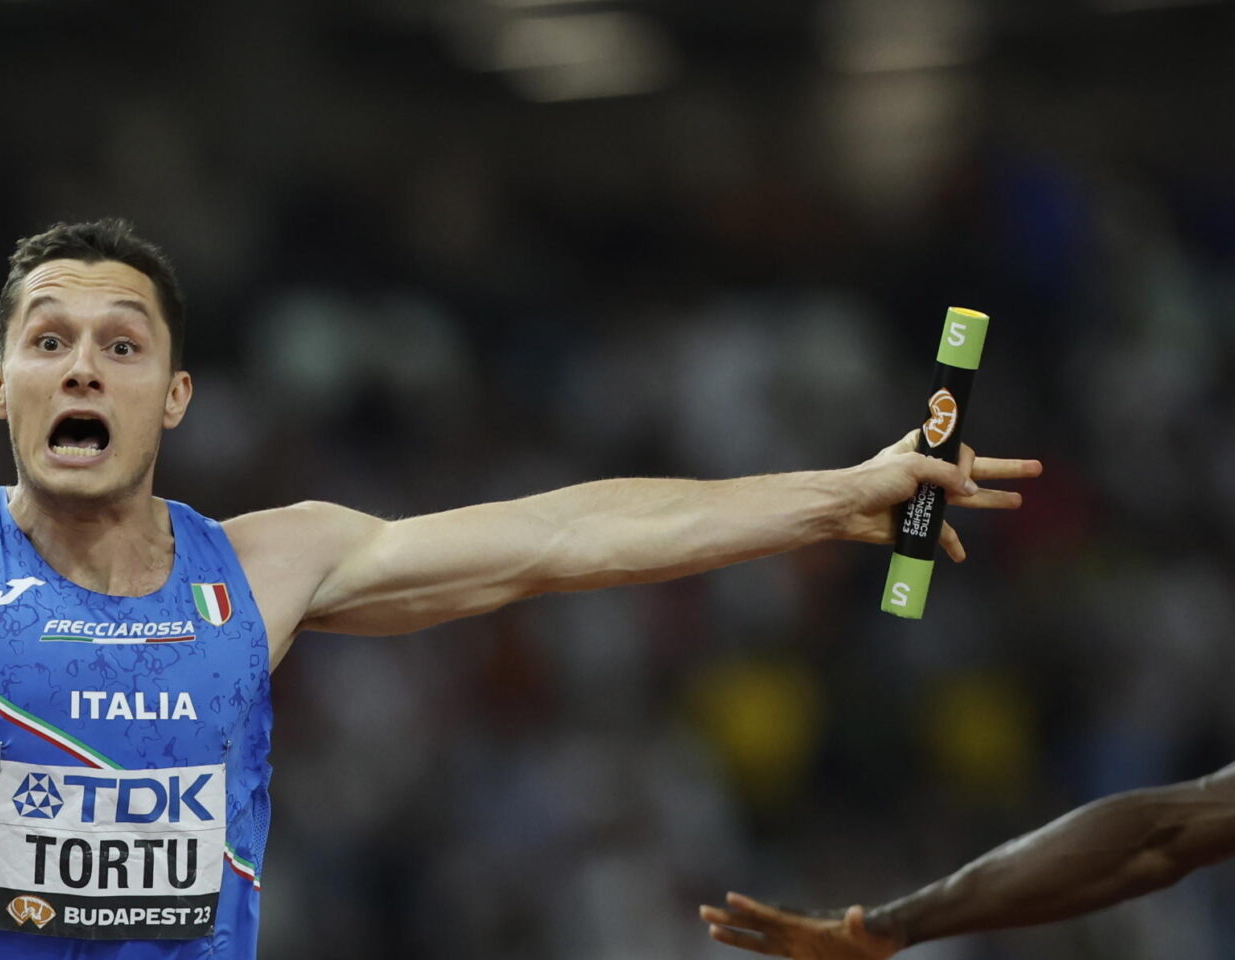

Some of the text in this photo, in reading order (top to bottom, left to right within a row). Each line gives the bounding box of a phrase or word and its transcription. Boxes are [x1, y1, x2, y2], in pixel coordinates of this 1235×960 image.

[947, 321, 967, 347] 5
[902, 518, 912, 534] 23
[919, 490, 936, 538] ATHLETICS
[890, 582, 911, 607] 5
[43, 619, 195, 636] FRECCIAROSSA
[70, 690, 198, 720] ITALIA
[63, 772, 215, 824] TDK
[25, 834, 198, 889] TORTU
[63, 905, 212, 926] BUDAPEST 23
